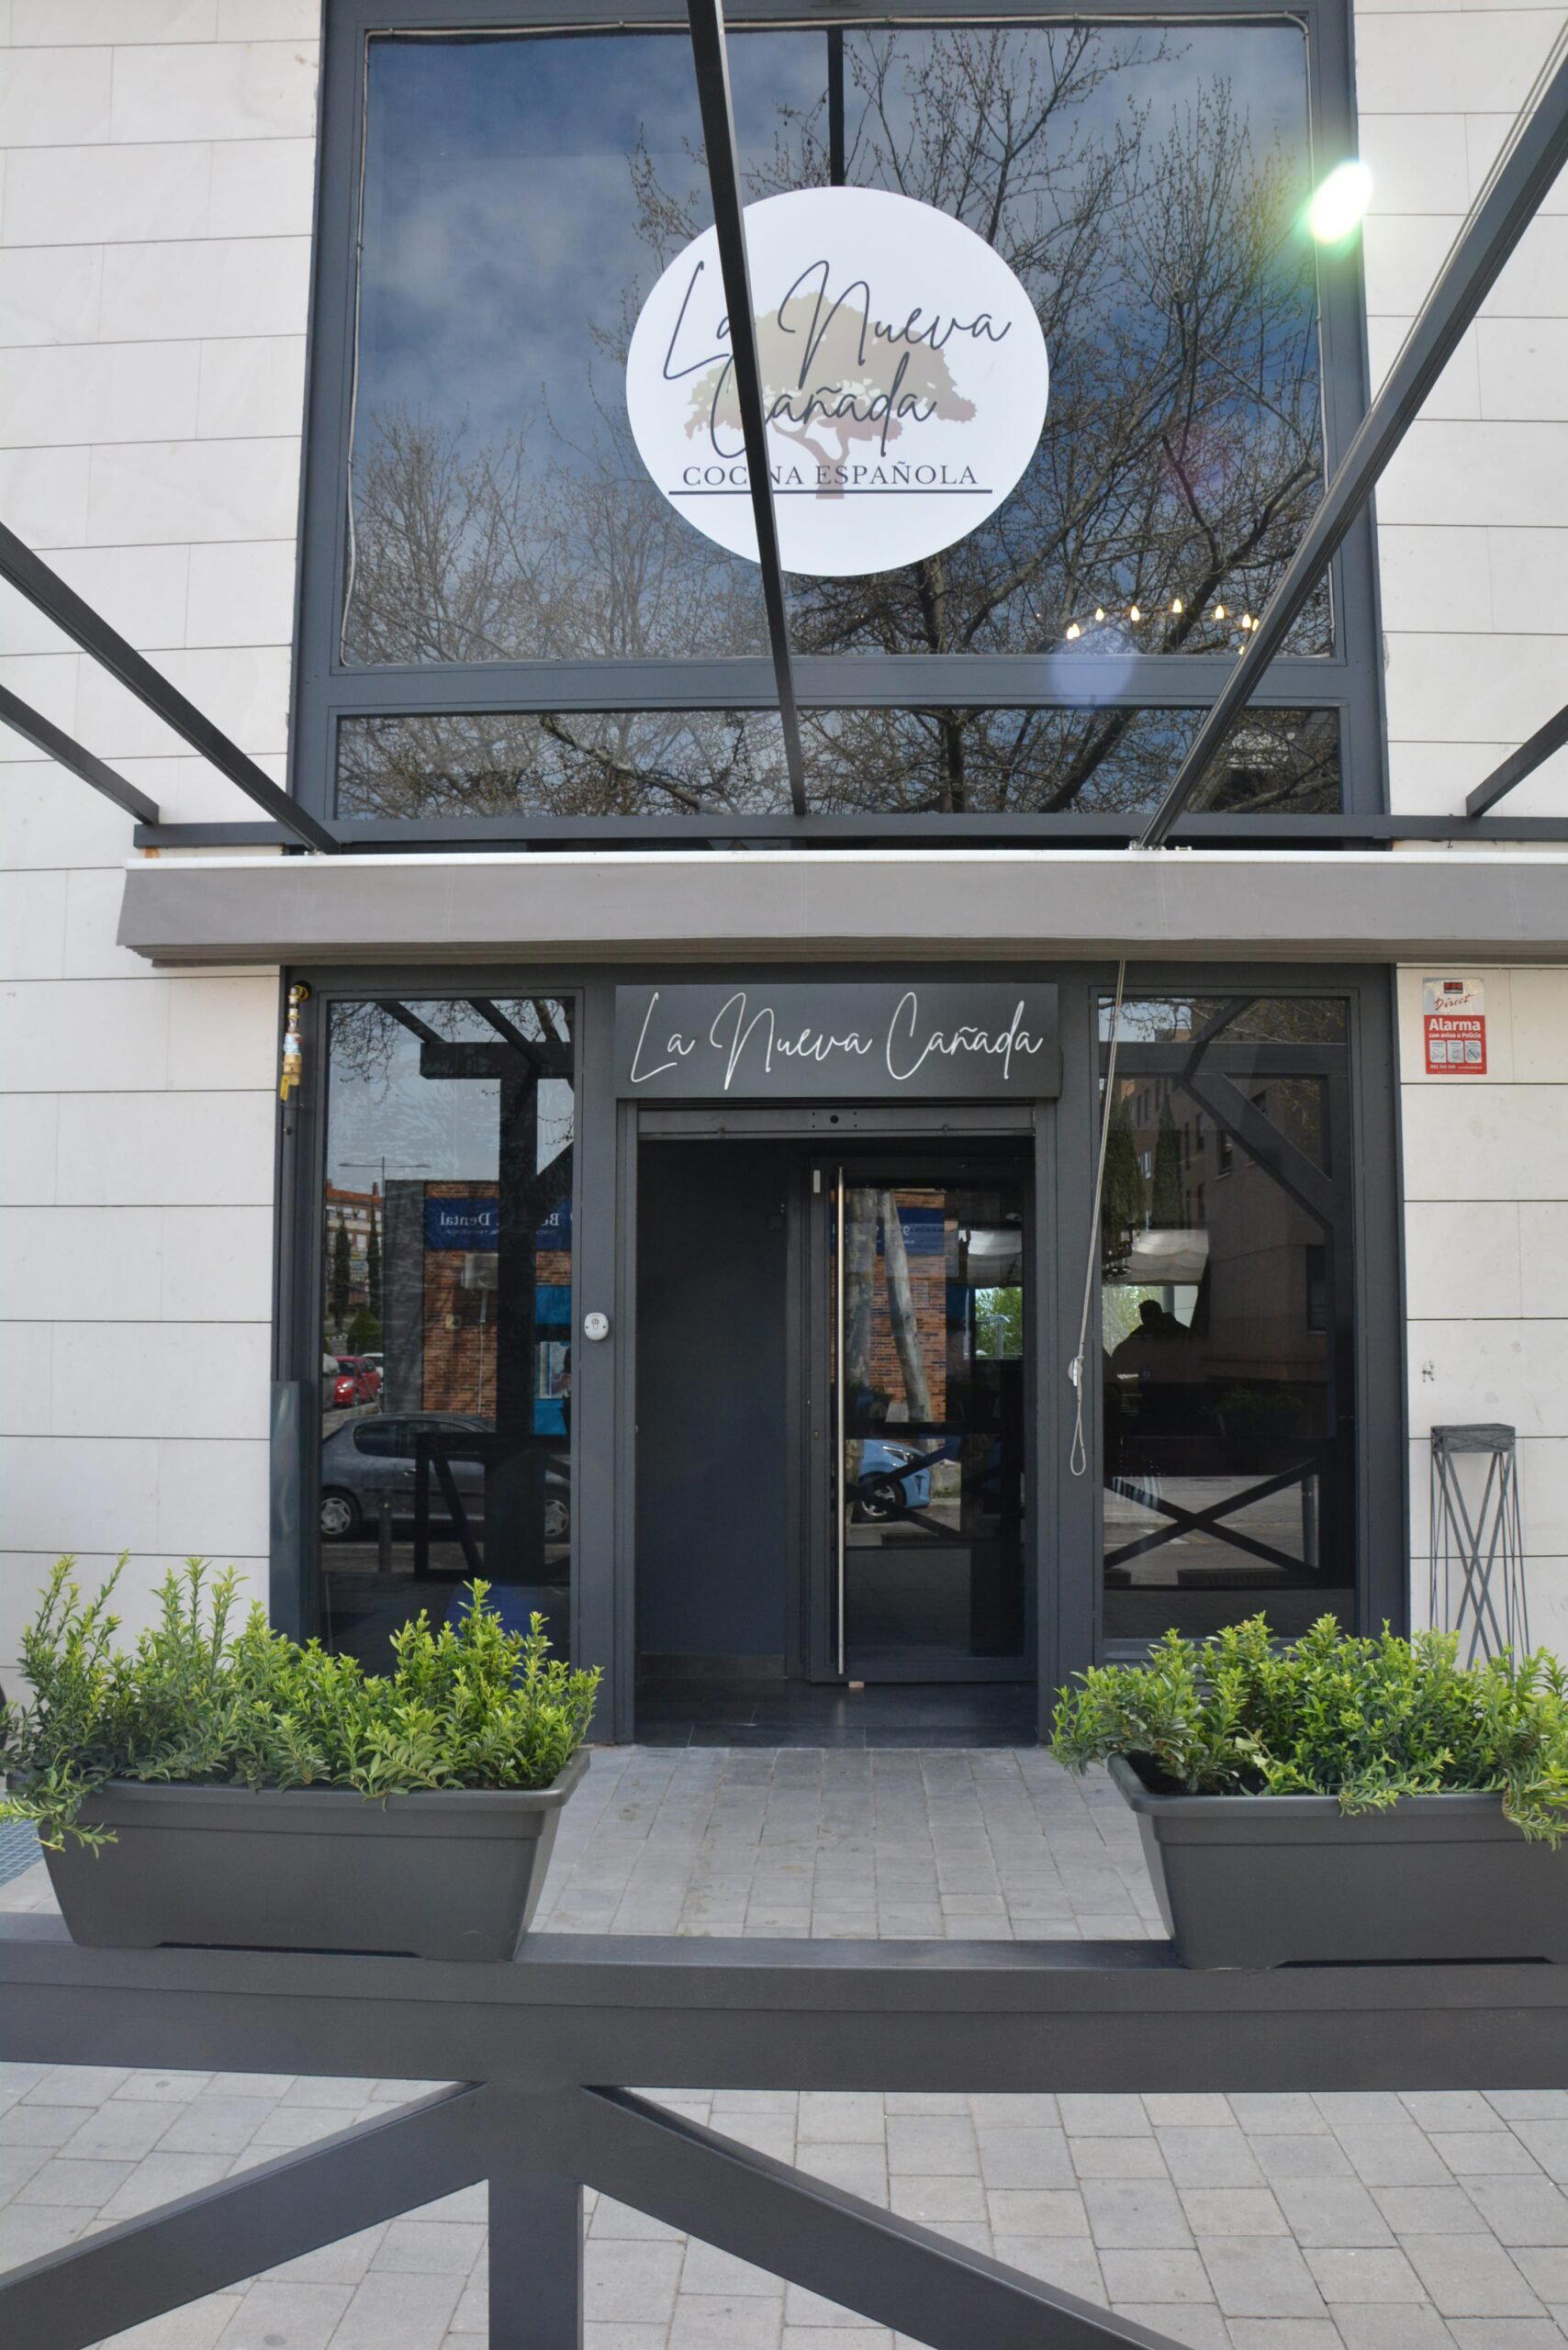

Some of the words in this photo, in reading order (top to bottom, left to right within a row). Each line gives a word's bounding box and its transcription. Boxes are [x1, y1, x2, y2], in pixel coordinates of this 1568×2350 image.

[777, 259, 1013, 390] Nueva
[682, 465, 803, 487] COCNA
[815, 461, 979, 486] ESPAÑOLA
[630, 991, 696, 1083] La
[709, 991, 873, 1091] Nueva
[886, 991, 1045, 1080] Cañada
[1428, 1018, 1481, 1031] Alarma
